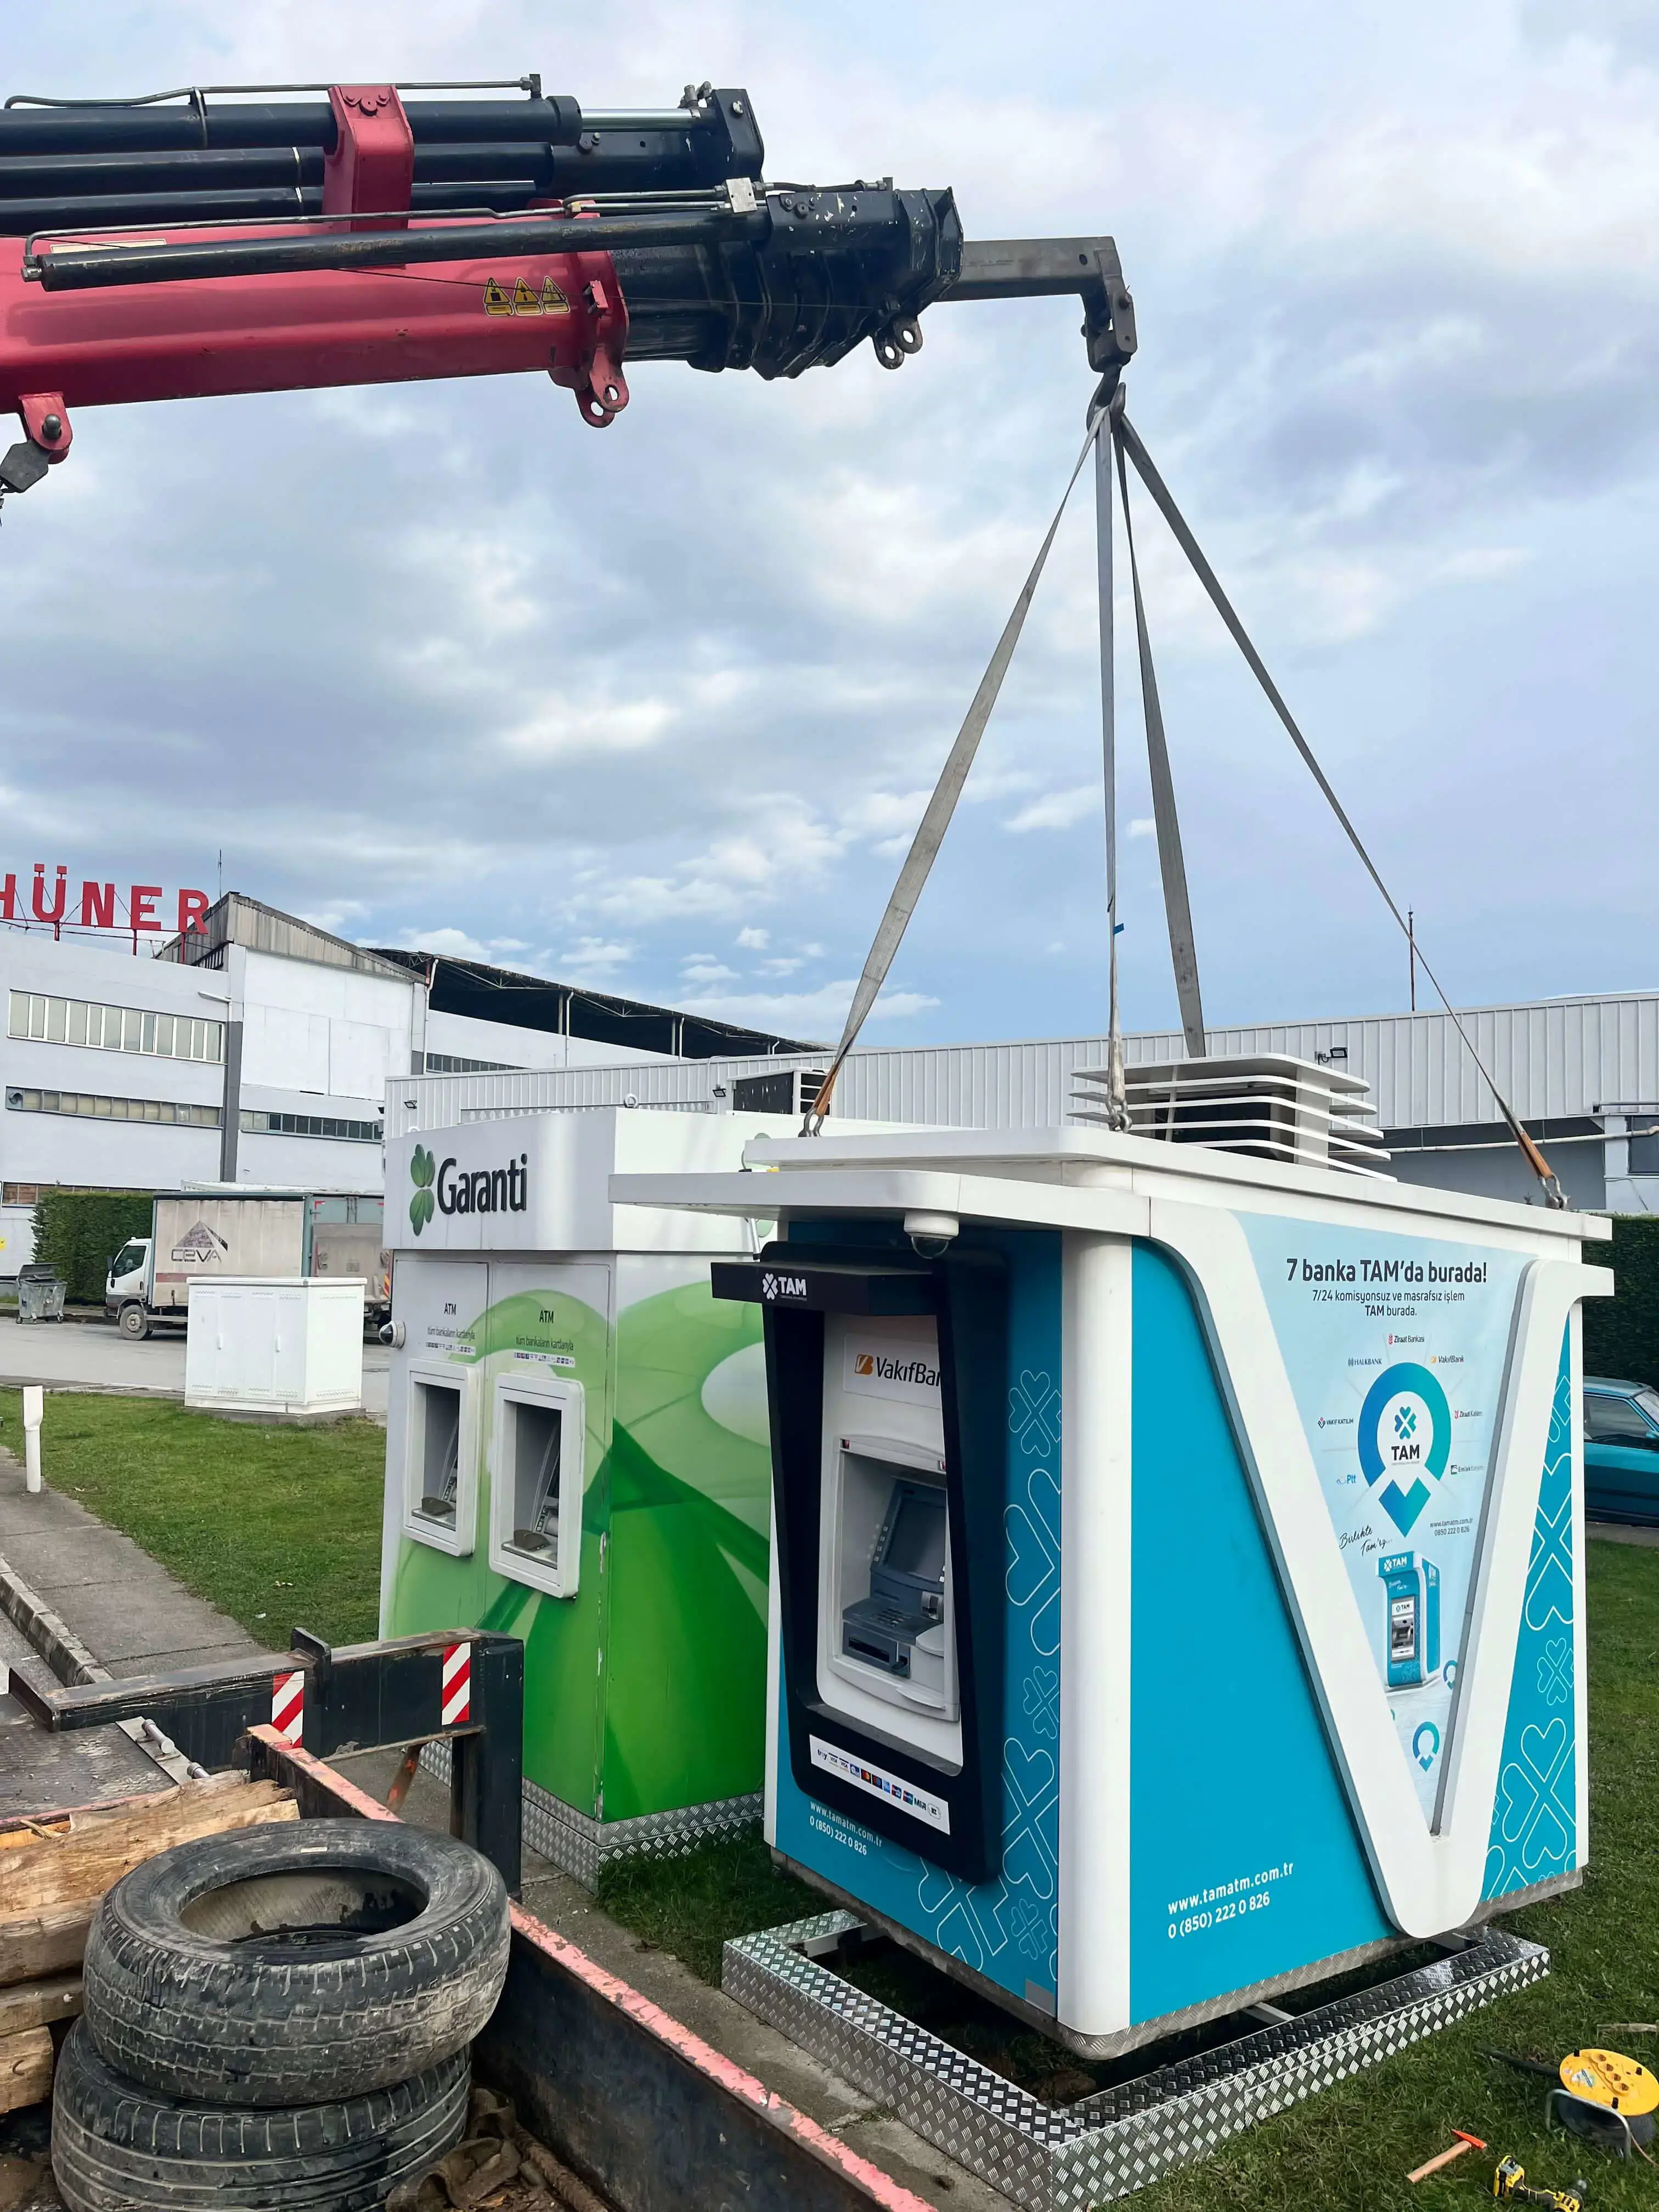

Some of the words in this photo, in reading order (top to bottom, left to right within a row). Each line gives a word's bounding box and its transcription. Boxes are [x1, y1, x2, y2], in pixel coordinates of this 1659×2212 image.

[437, 1153, 528, 1215] Garanti
[171, 1249, 222, 1263] CEVA
[1287, 1259, 1298, 1282] 7
[1303, 1259, 1356, 1282] banka
[1429, 1261, 1487, 1283] burada!
[778, 1277, 806, 1296] TAM
[1312, 1290, 1333, 1301] 7/24
[1335, 1290, 1390, 1304] komisyonsuz
[1392, 1293, 1402, 1301] ve
[1404, 1290, 1442, 1302] masrafsız
[1444, 1290, 1465, 1304] işlem
[444, 1303, 456, 1315] ATM
[539, 1310, 554, 1323] ATM
[1365, 1305, 1384, 1316] TAM
[1386, 1305, 1417, 1317] burada.
[877, 1357, 940, 1387] VakıfBa
[1391, 1444, 1420, 1461] TAM
[1347, 1475, 1356, 1484] Ptt
[1392, 1556, 1407, 1567] TAM
[810, 1801, 882, 1848] www.tamatm.com.tr
[810, 1815, 815, 1826] 0
[816, 1819, 834, 1838] (850)
[835, 1829, 847, 1845] 222
[848, 1836, 853, 1848] 0
[854, 1840, 867, 1856] 826
[1167, 1861, 1294, 1915] www.tamatm.com.tr
[1167, 1923, 1177, 1939] 0
[1179, 1911, 1213, 1938] (850)
[1215, 1903, 1236, 1923] 222
[1238, 1899, 1246, 1914] 0
[1249, 1891, 1271, 1911] 826
